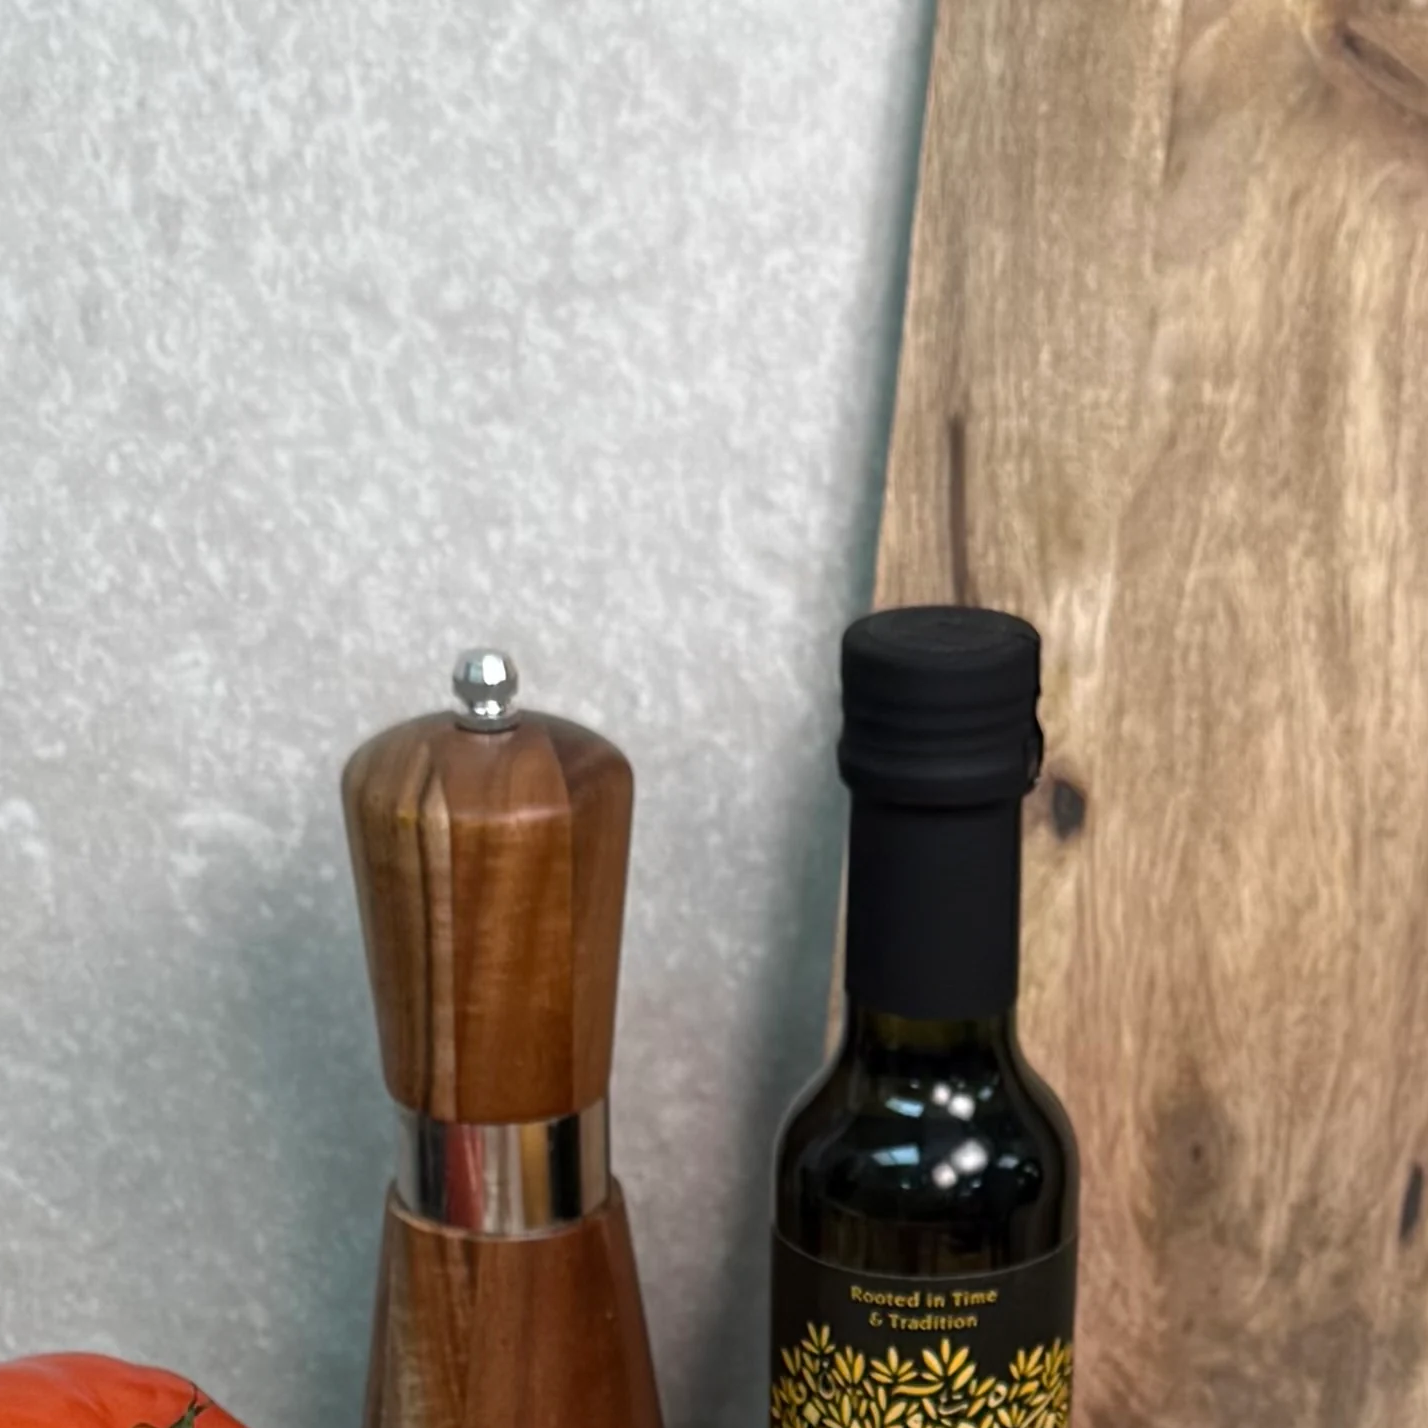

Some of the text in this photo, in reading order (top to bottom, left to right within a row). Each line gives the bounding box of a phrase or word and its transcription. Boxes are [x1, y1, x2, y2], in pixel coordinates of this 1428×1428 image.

[850, 1284, 998, 1308] Rooted in Time
[869, 1311, 978, 1330] & Tradition
